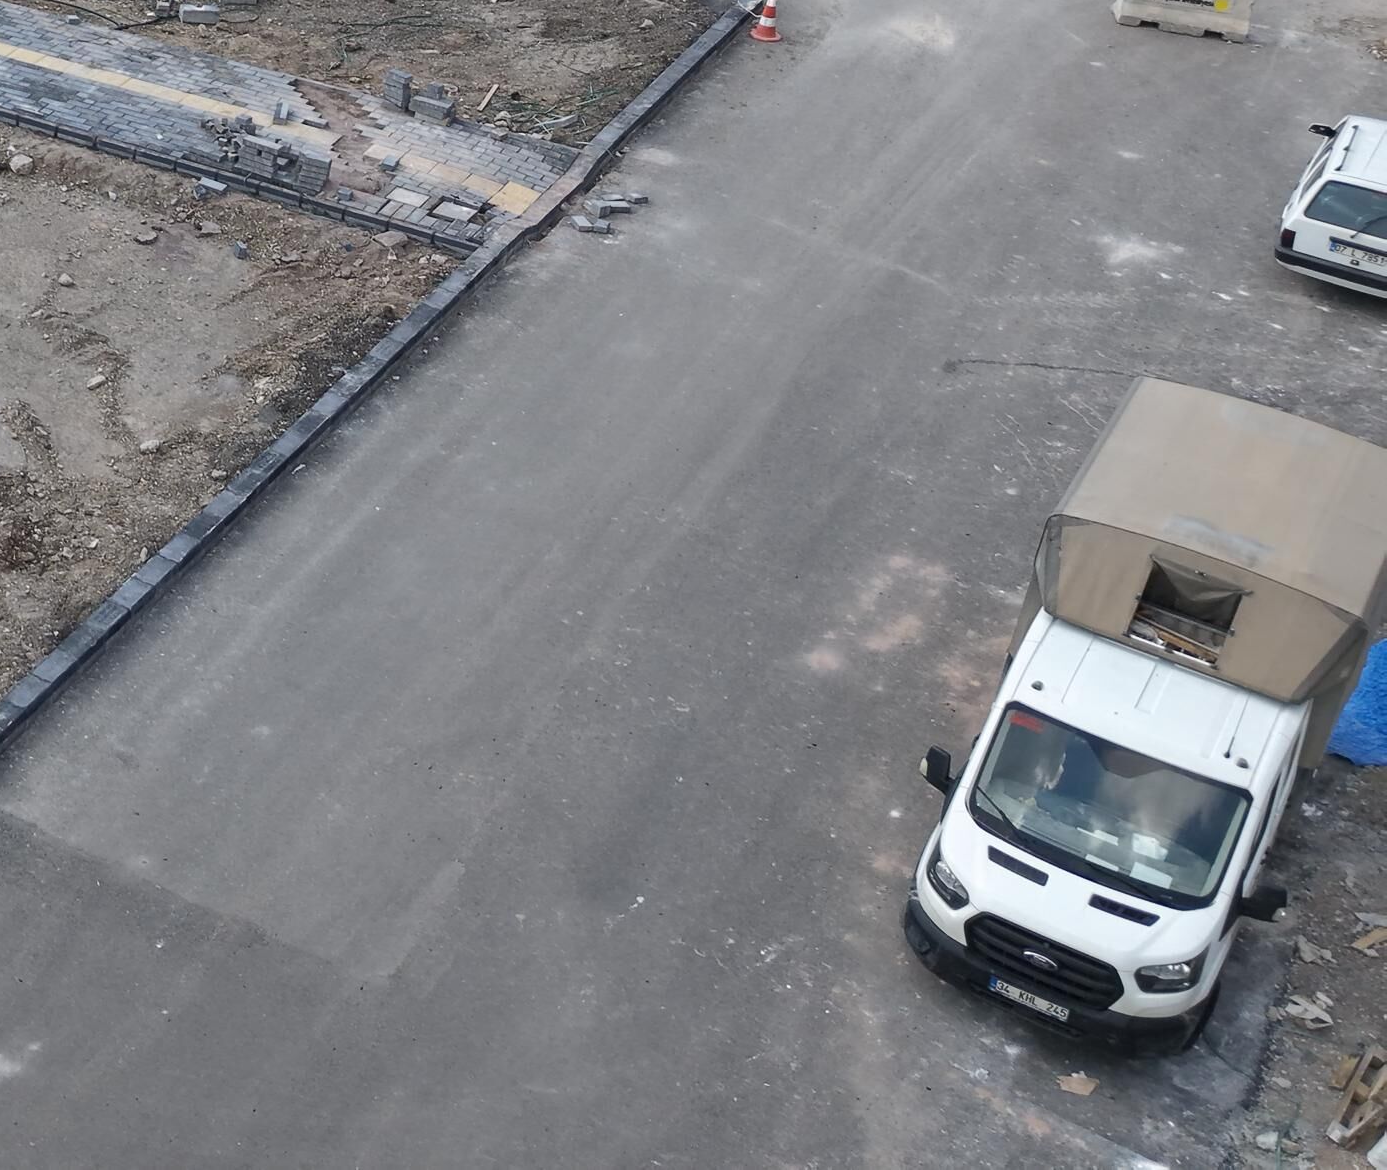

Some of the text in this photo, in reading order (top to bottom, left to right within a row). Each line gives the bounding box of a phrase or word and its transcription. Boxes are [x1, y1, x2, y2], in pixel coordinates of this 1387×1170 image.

[997, 981, 1068, 1018] 34 KHL 245
